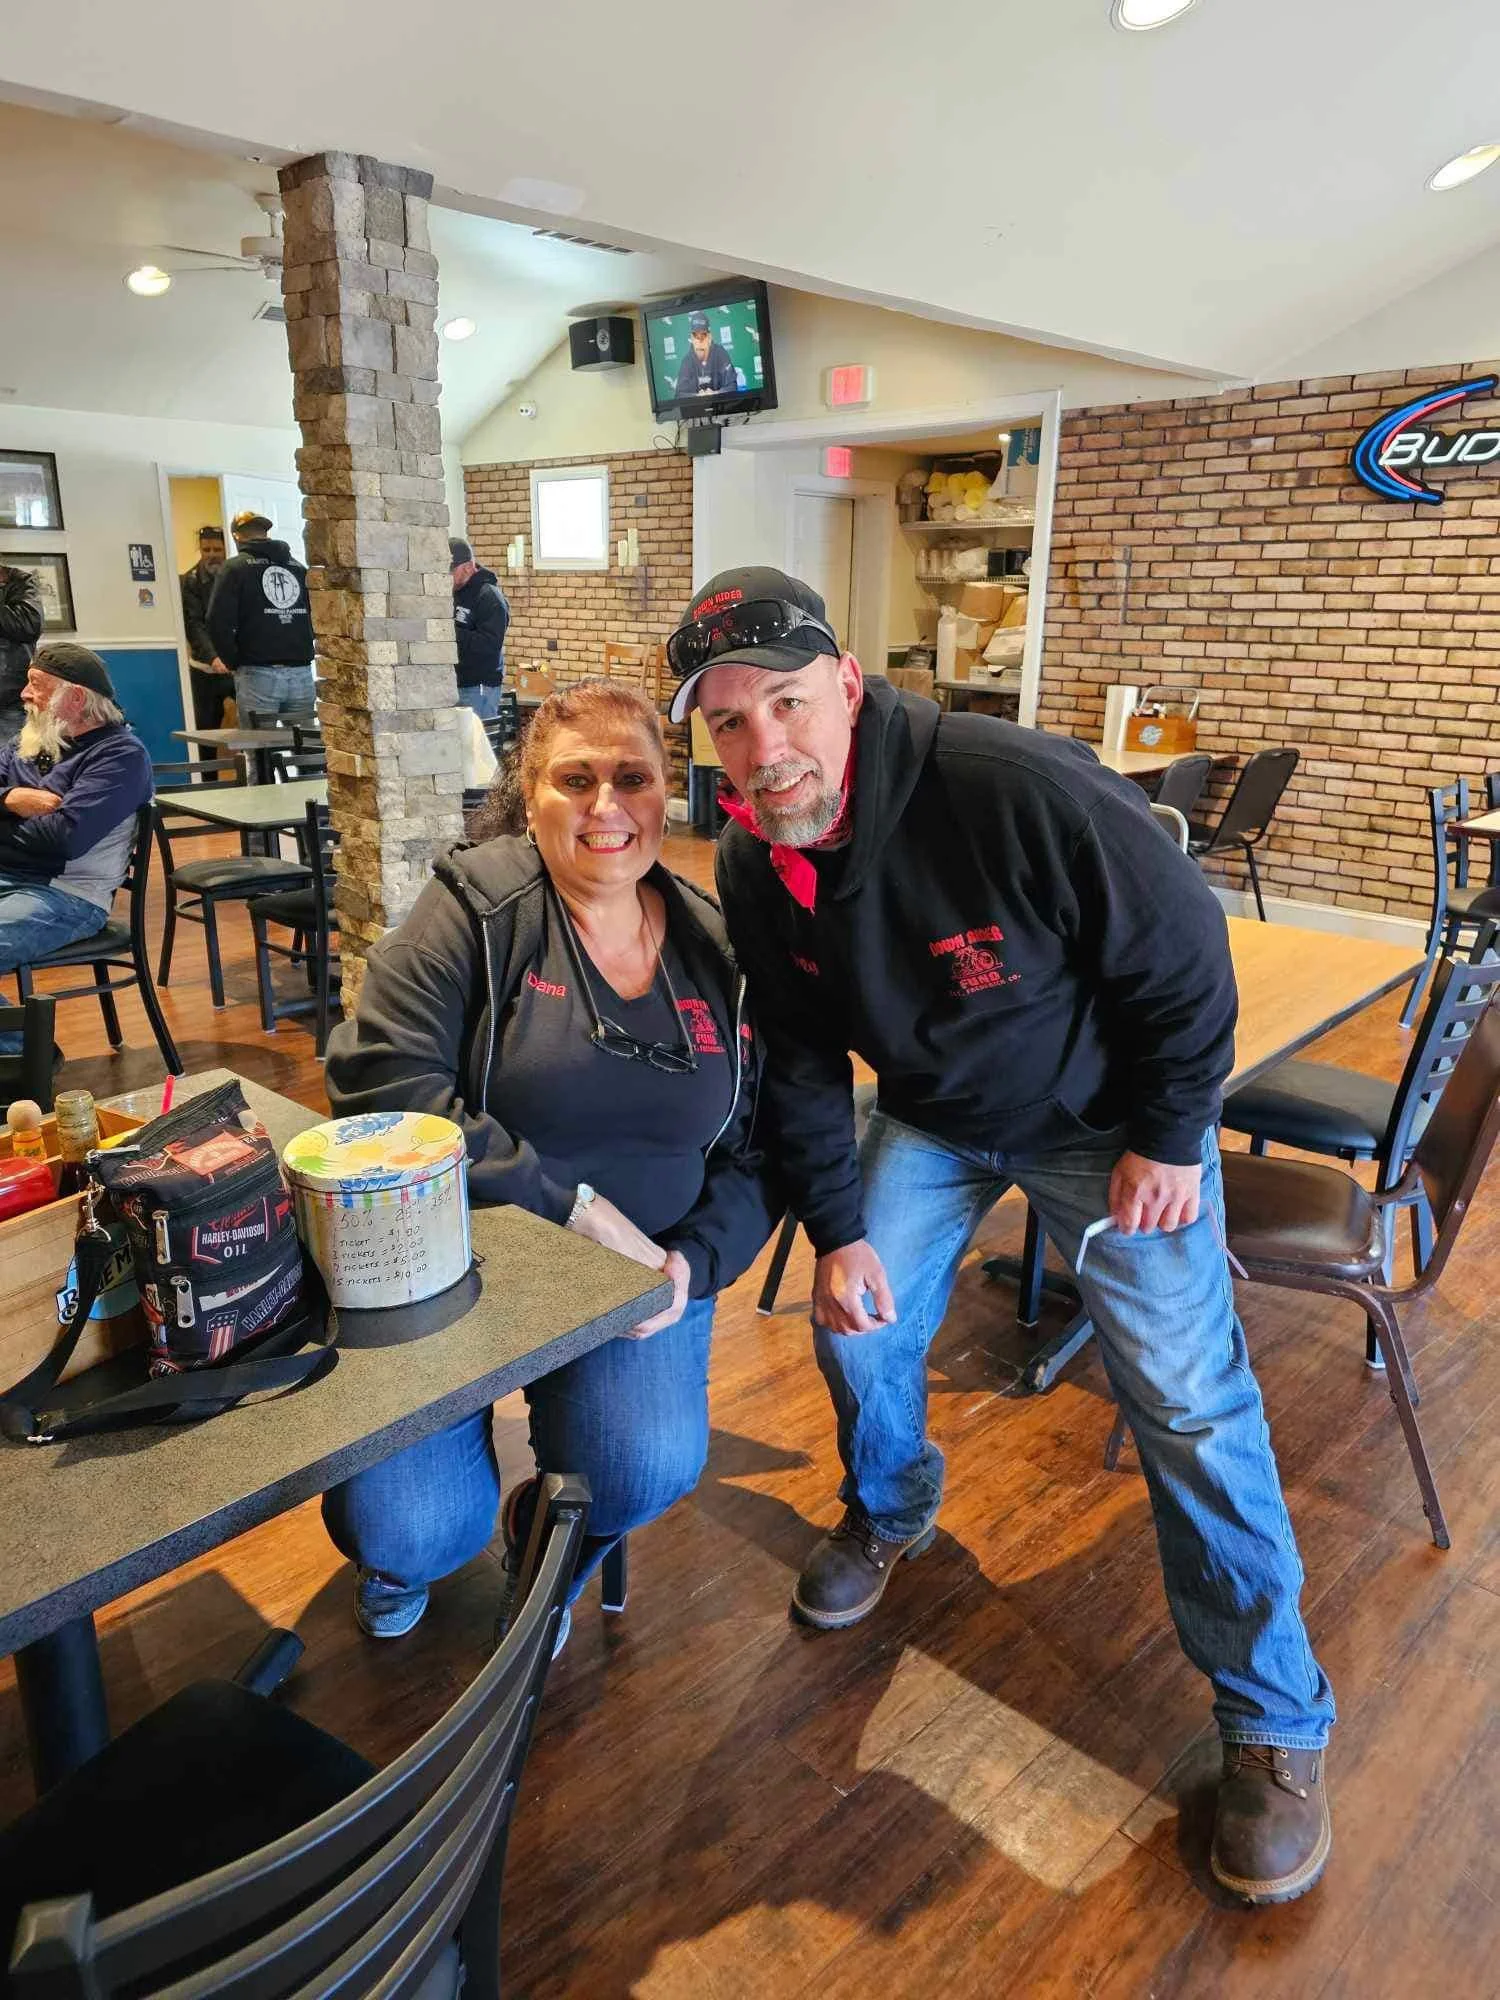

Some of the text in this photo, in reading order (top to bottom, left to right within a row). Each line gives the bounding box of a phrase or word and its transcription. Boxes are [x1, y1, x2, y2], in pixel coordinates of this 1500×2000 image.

[1378, 432, 1500, 466] BUD
[528, 972, 567, 997] Dana
[336, 1209, 373, 1230] 50%
[202, 1223, 265, 1245] HARLEY-DAVIDSON
[224, 1244, 247, 1258] OIL
